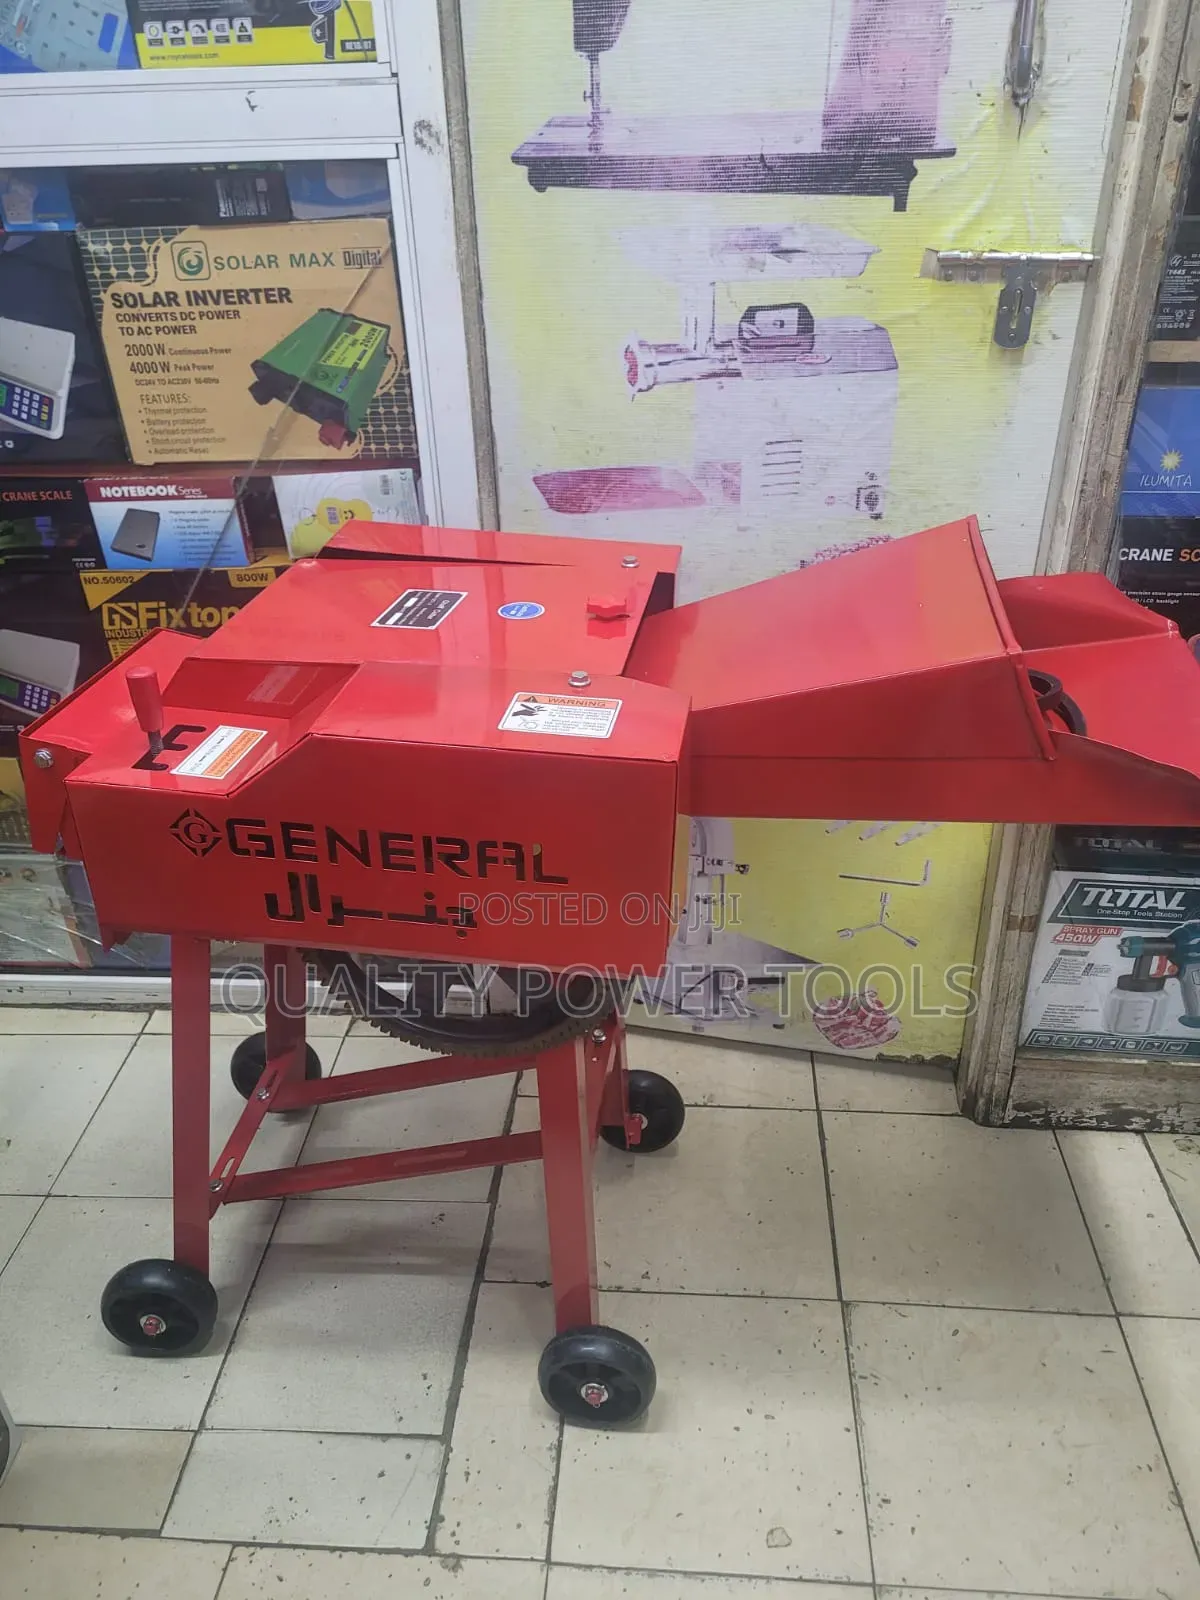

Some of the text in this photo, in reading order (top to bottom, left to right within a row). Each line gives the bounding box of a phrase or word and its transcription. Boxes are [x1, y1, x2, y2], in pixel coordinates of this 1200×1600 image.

[214, 249, 382, 271] SOLAR MAX Digital
[111, 287, 293, 309] SOLAR INVERTER
[116, 309, 241, 323] CONVERTS DC POWER
[119, 325, 197, 336] TO AC POWER
[125, 343, 166, 357] 2000W
[130, 361, 170, 374] 4000W
[1140, 474, 1192, 488] ILUMITA
[2, 490, 73, 501] CRANE SCALE
[100, 485, 178, 498] NOTEBOOK
[178, 486, 202, 495] Series
[1119, 548, 1175, 561] CRANE
[83, 573, 269, 585] NO.50602 800W
[104, 628, 150, 639] INDUSTR
[548, 697, 606, 707] WARNING
[225, 817, 569, 886] GENERAL
[1082, 887, 1187, 911] TOTAL
[1097, 908, 1131, 916] One-Stop
[1133, 909, 1153, 917] Tools
[1063, 925, 1118, 935] SPRAY GUN
[1056, 933, 1098, 943] 450W
